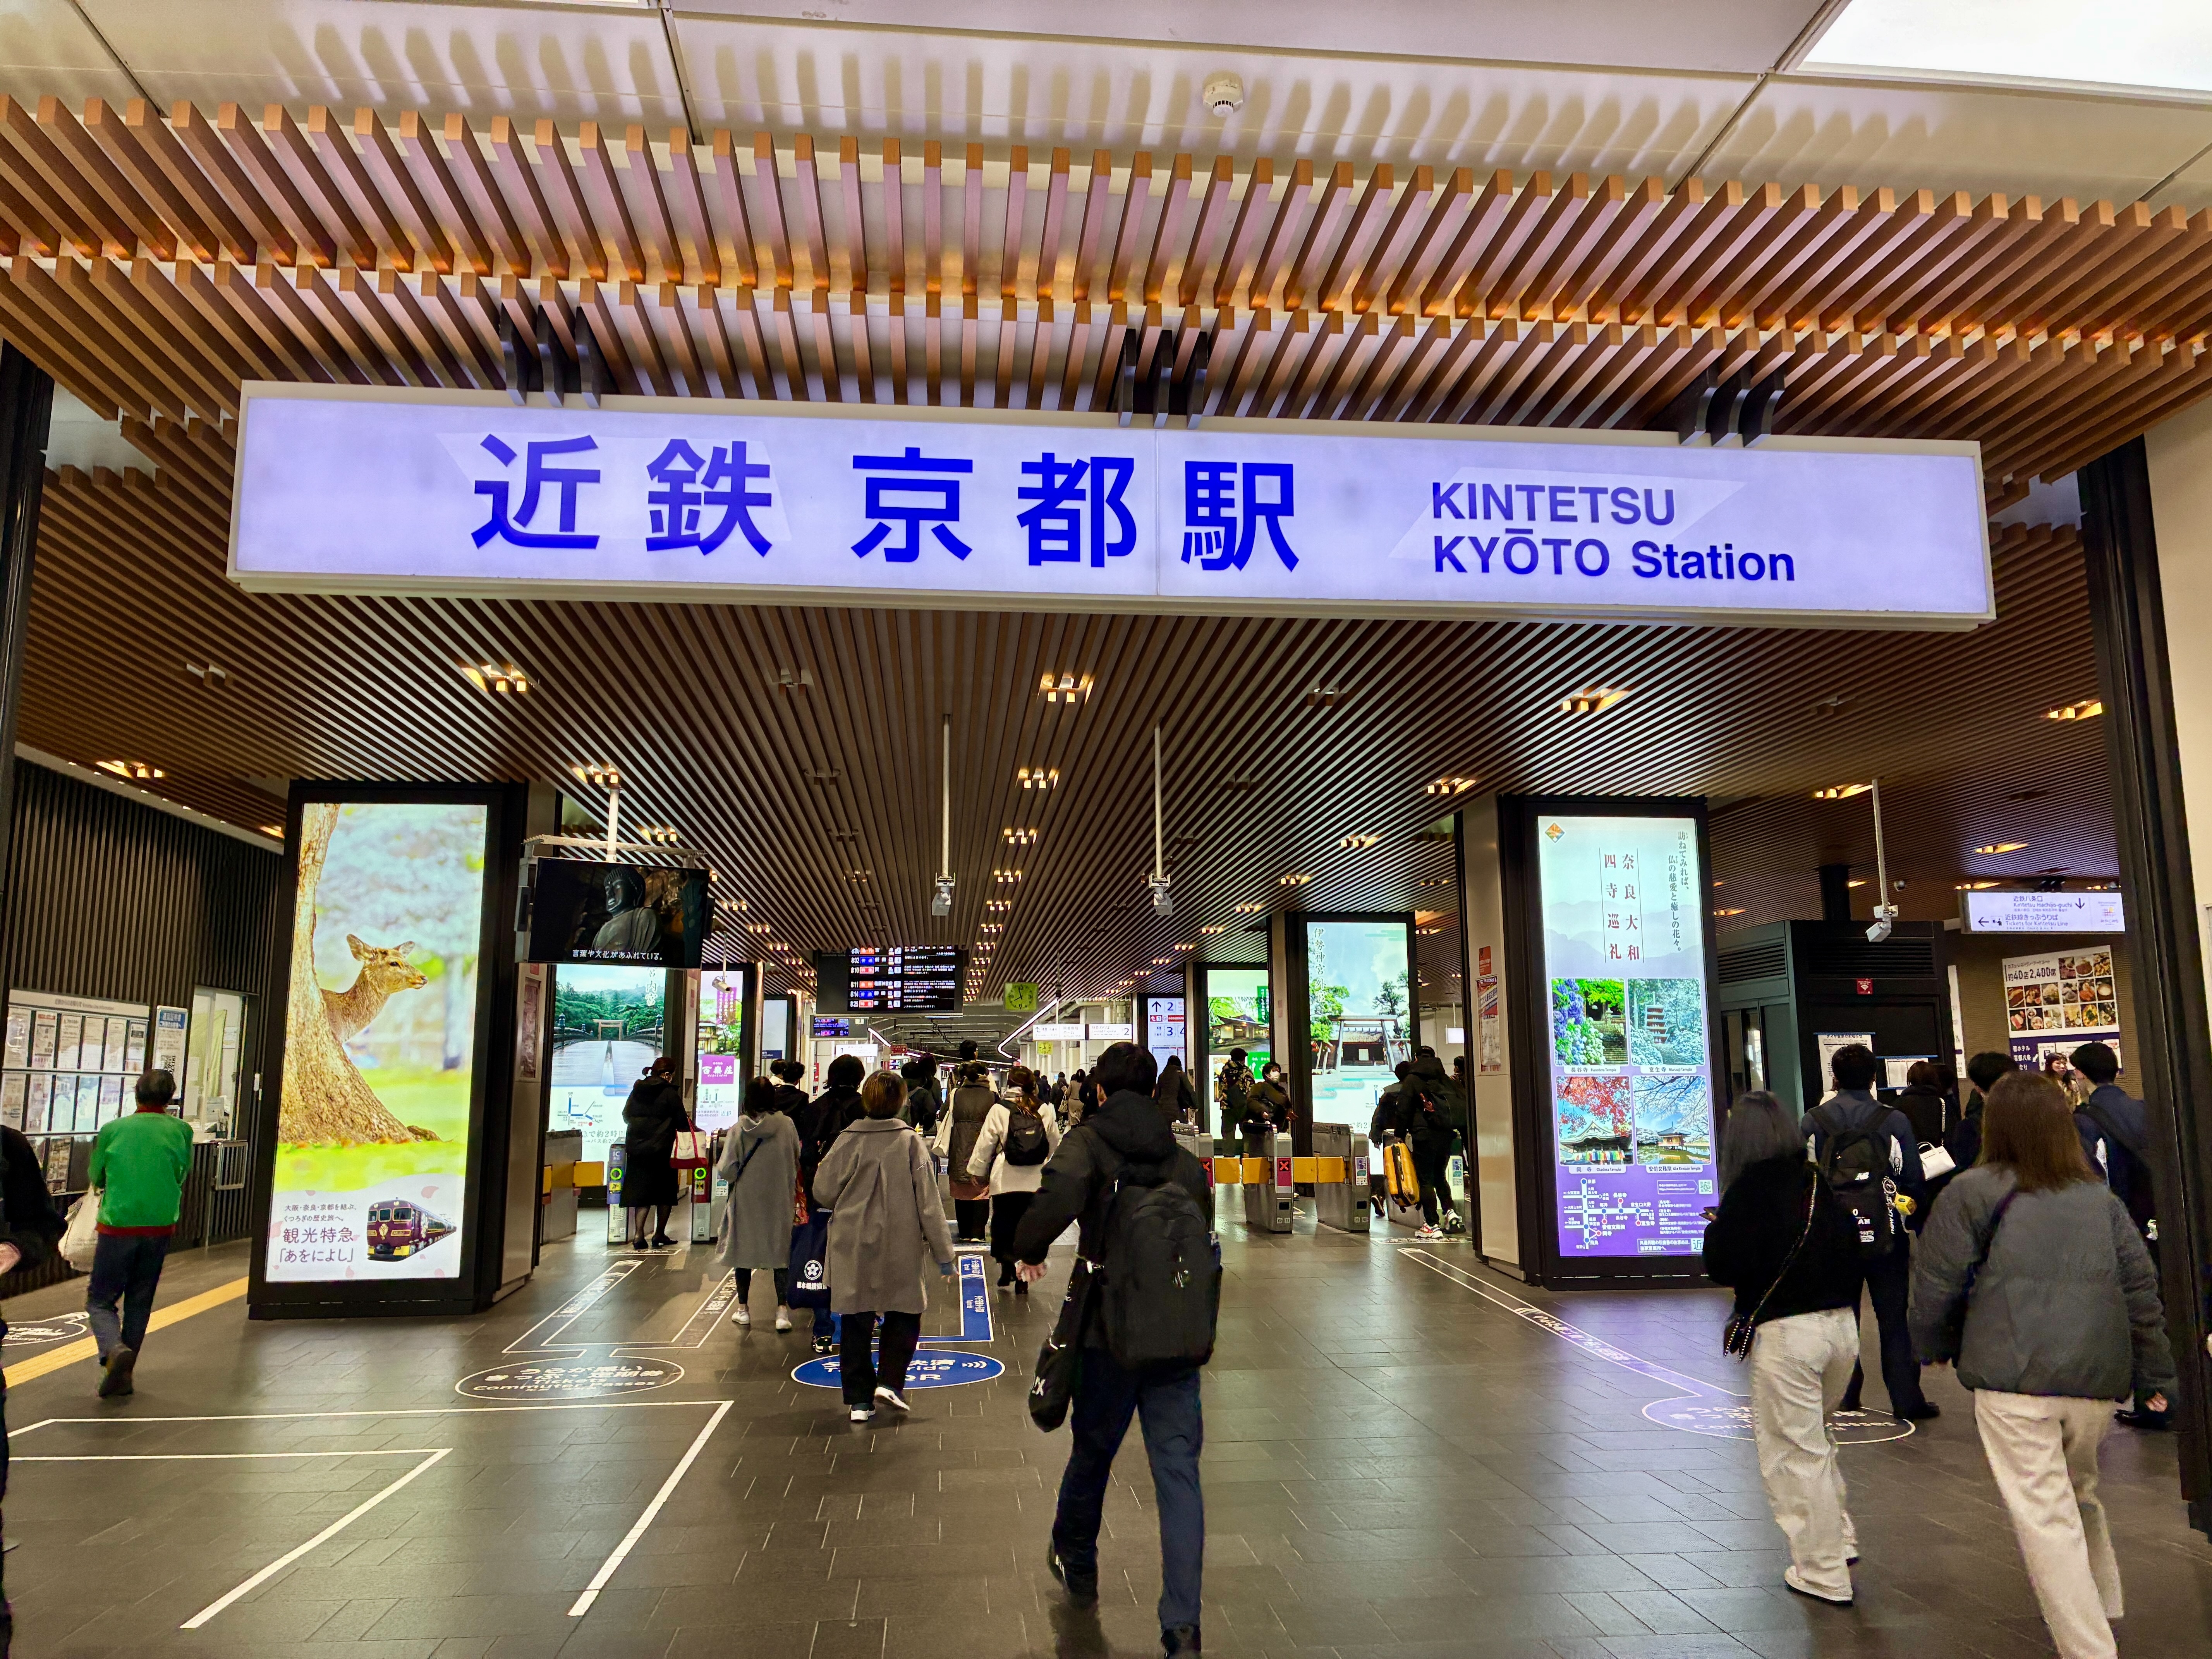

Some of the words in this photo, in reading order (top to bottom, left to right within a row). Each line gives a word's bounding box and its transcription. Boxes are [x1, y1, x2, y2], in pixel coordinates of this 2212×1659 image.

[1432, 482, 1675, 526] KINTETSU
[1434, 528, 1610, 576] KYŌTO
[1632, 540, 1795, 582] Station
[1604, 854, 1622, 960] 四寺巡礼
[1622, 854, 1640, 961] 奈良大和
[572, 950, 663, 960] 言葉や文化があふれている。
[1167, 1002, 1173, 1011] 2
[1167, 1027, 1173, 1036] 3
[284, 1203, 357, 1212] 大阪・奈良・京都を結ぶ、
[283, 1226, 354, 1244] 観光特急
[280, 1248, 354, 1262] 「あをによし」
